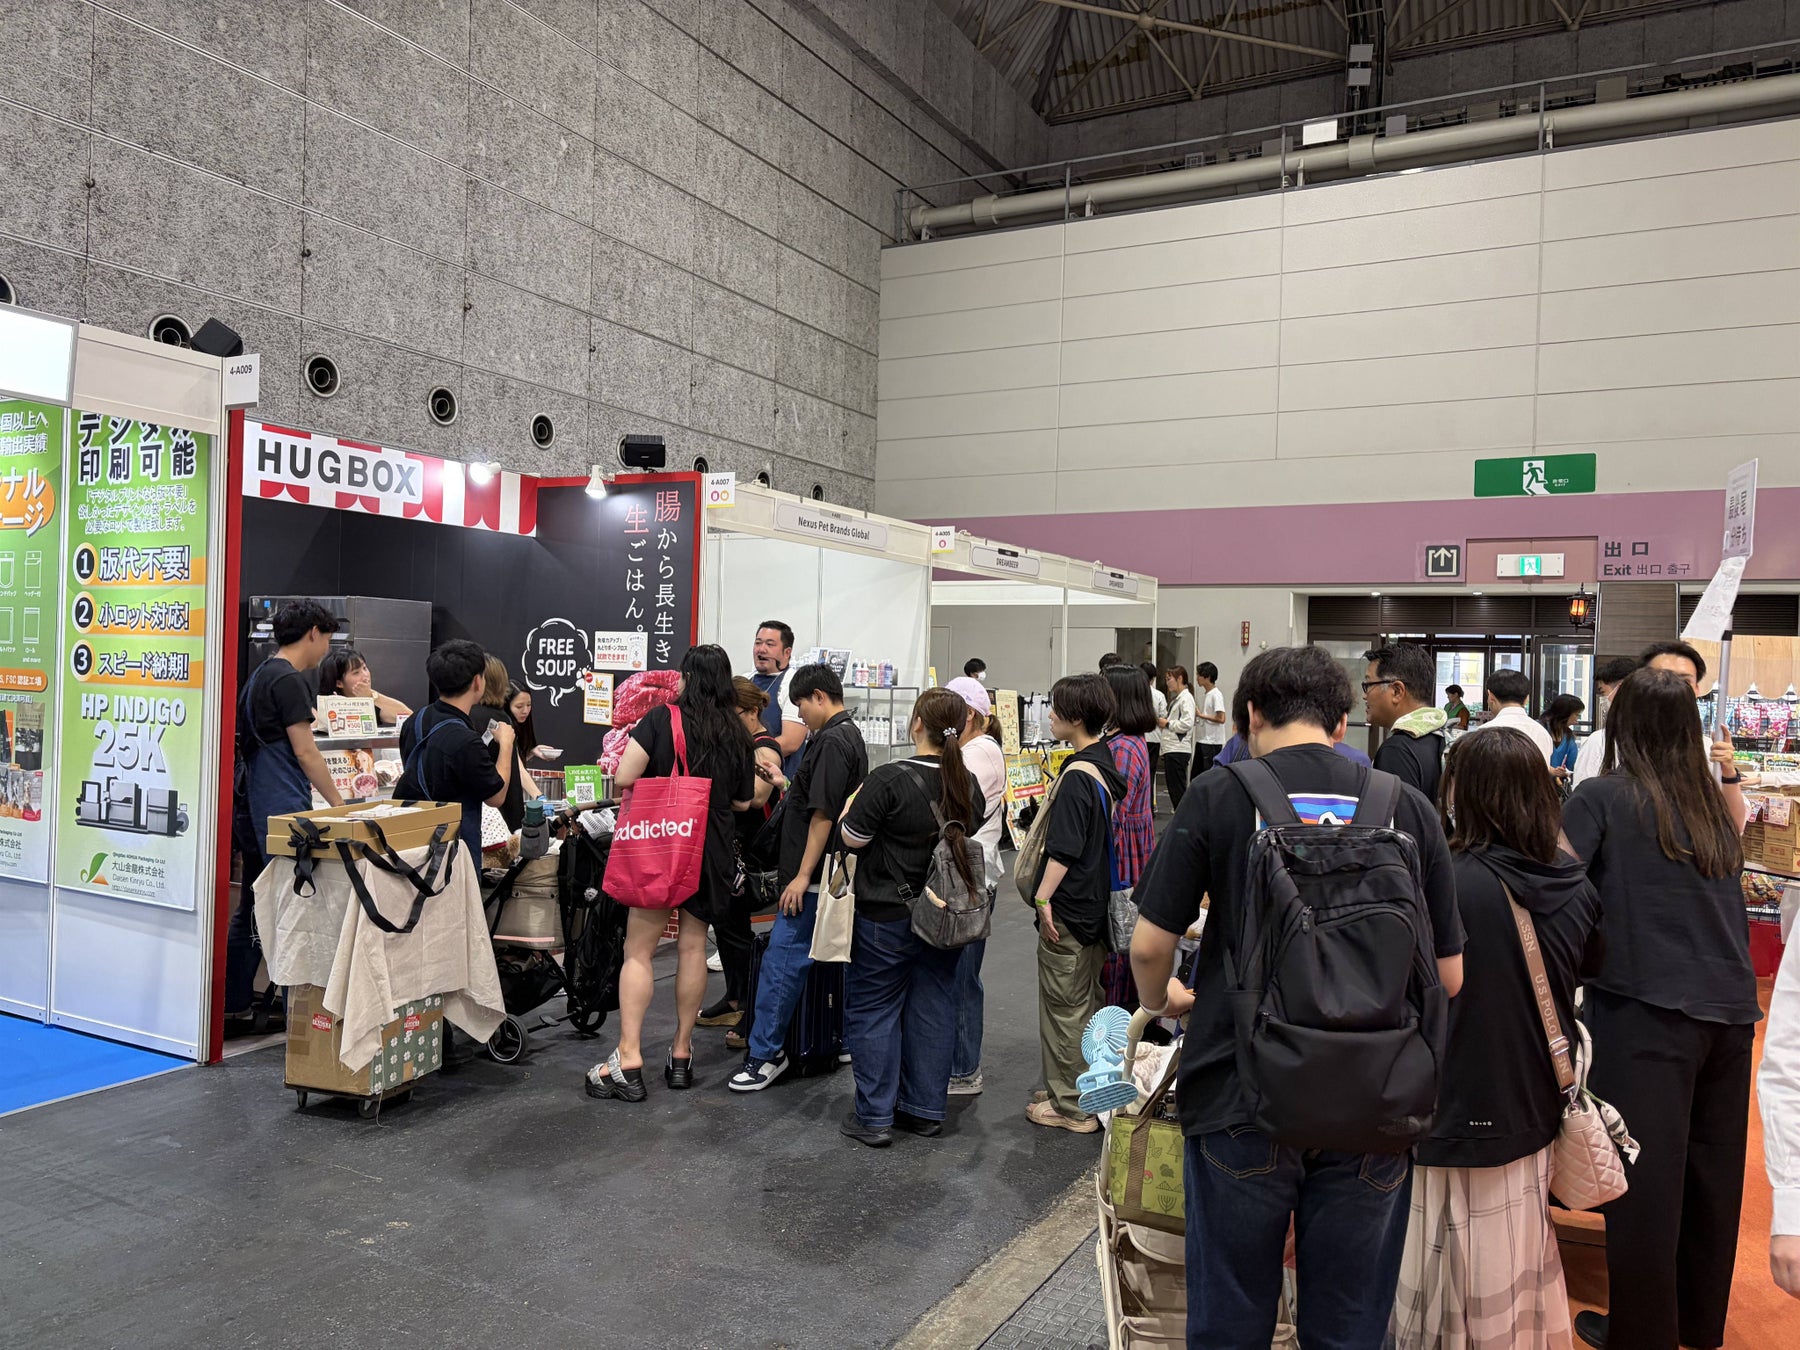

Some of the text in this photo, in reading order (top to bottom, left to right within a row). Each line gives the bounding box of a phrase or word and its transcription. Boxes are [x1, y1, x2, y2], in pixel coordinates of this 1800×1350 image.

[230, 364, 253, 375] 4-A009
[79, 440, 195, 482] 印刷可能
[258, 438, 416, 496] HUGBOX
[798, 516, 818, 530] Nexus
[818, 521, 829, 532] Pet
[830, 524, 850, 537] Brands
[851, 528, 870, 541] Global
[624, 504, 650, 634] 生ごはん。
[654, 490, 682, 664] 腸から長生き
[1604, 564, 1632, 576] Exit
[1636, 564, 1662, 576] 出口
[538, 638, 574, 656] FREE
[536, 658, 576, 676] SOUP
[81, 693, 186, 727] HP INDIGO
[94, 719, 166, 773] 25K
[1518, 916, 1537, 958] SSN.
